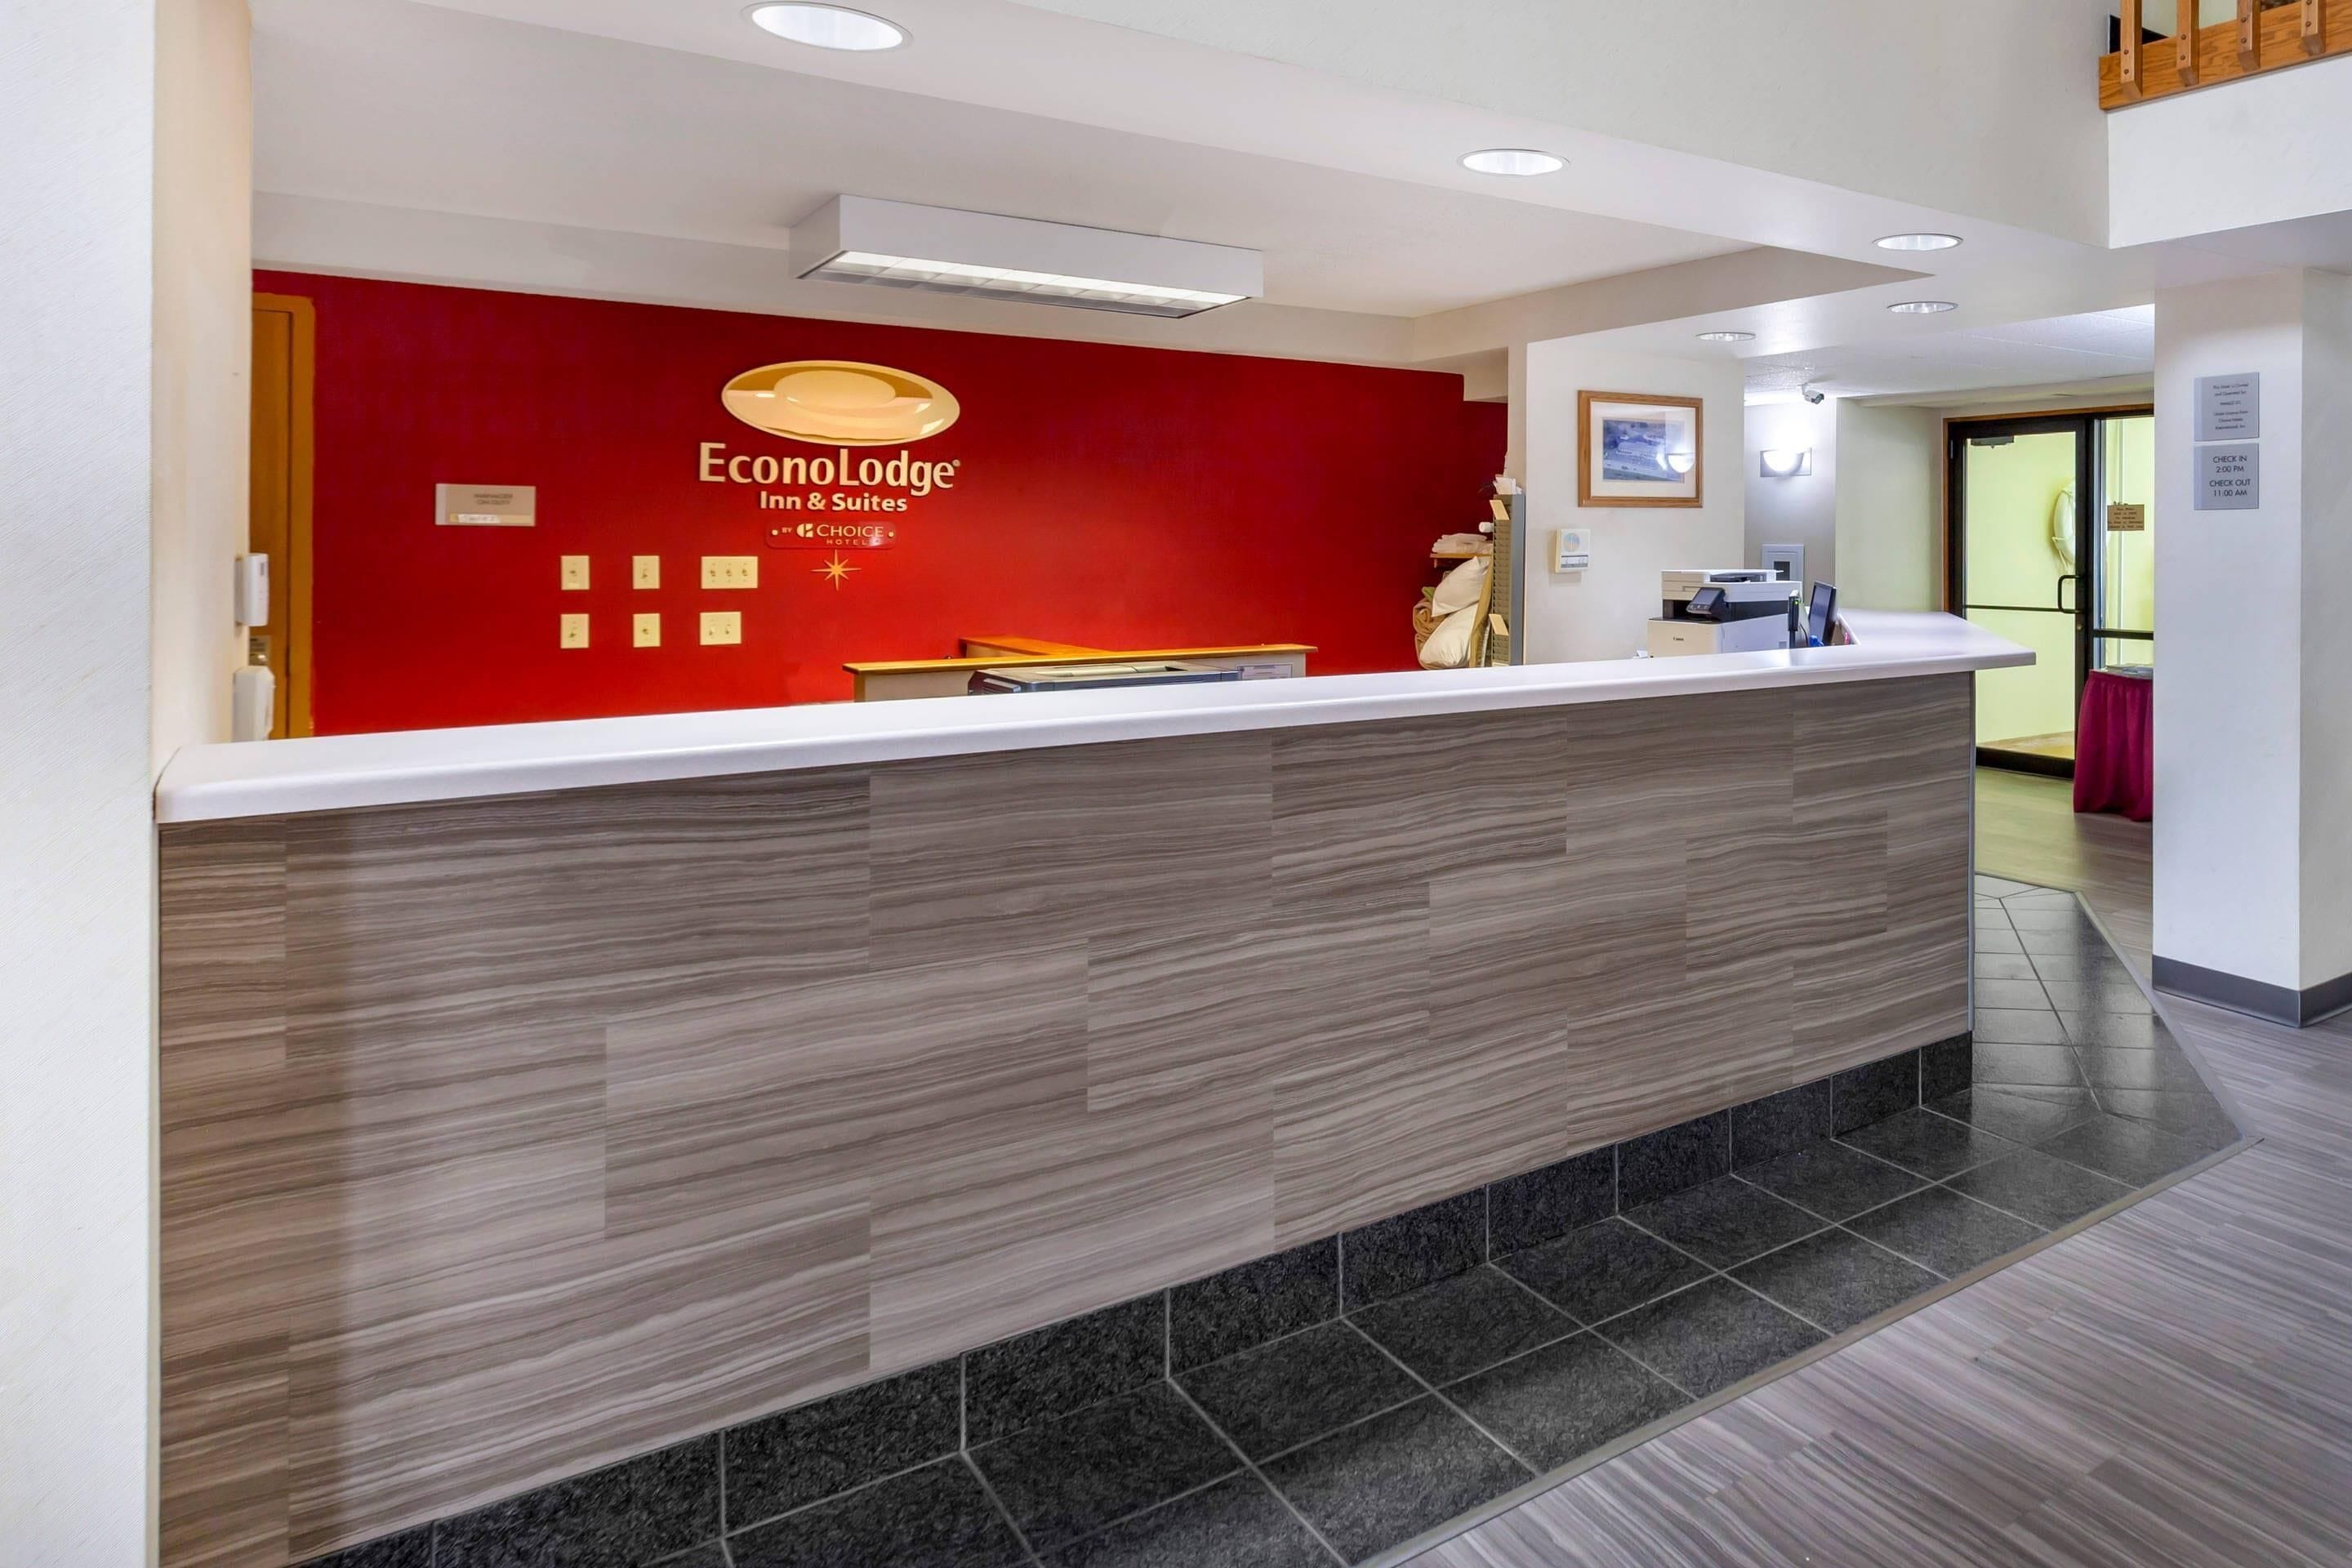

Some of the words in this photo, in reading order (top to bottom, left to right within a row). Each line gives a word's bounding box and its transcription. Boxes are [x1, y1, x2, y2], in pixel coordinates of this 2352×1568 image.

[2235, 479, 2251, 487] OUT
[760, 491, 801, 510] Inn
[807, 492, 826, 510] &
[831, 493, 908, 512] Suites
[817, 524, 884, 537] CHOICE
